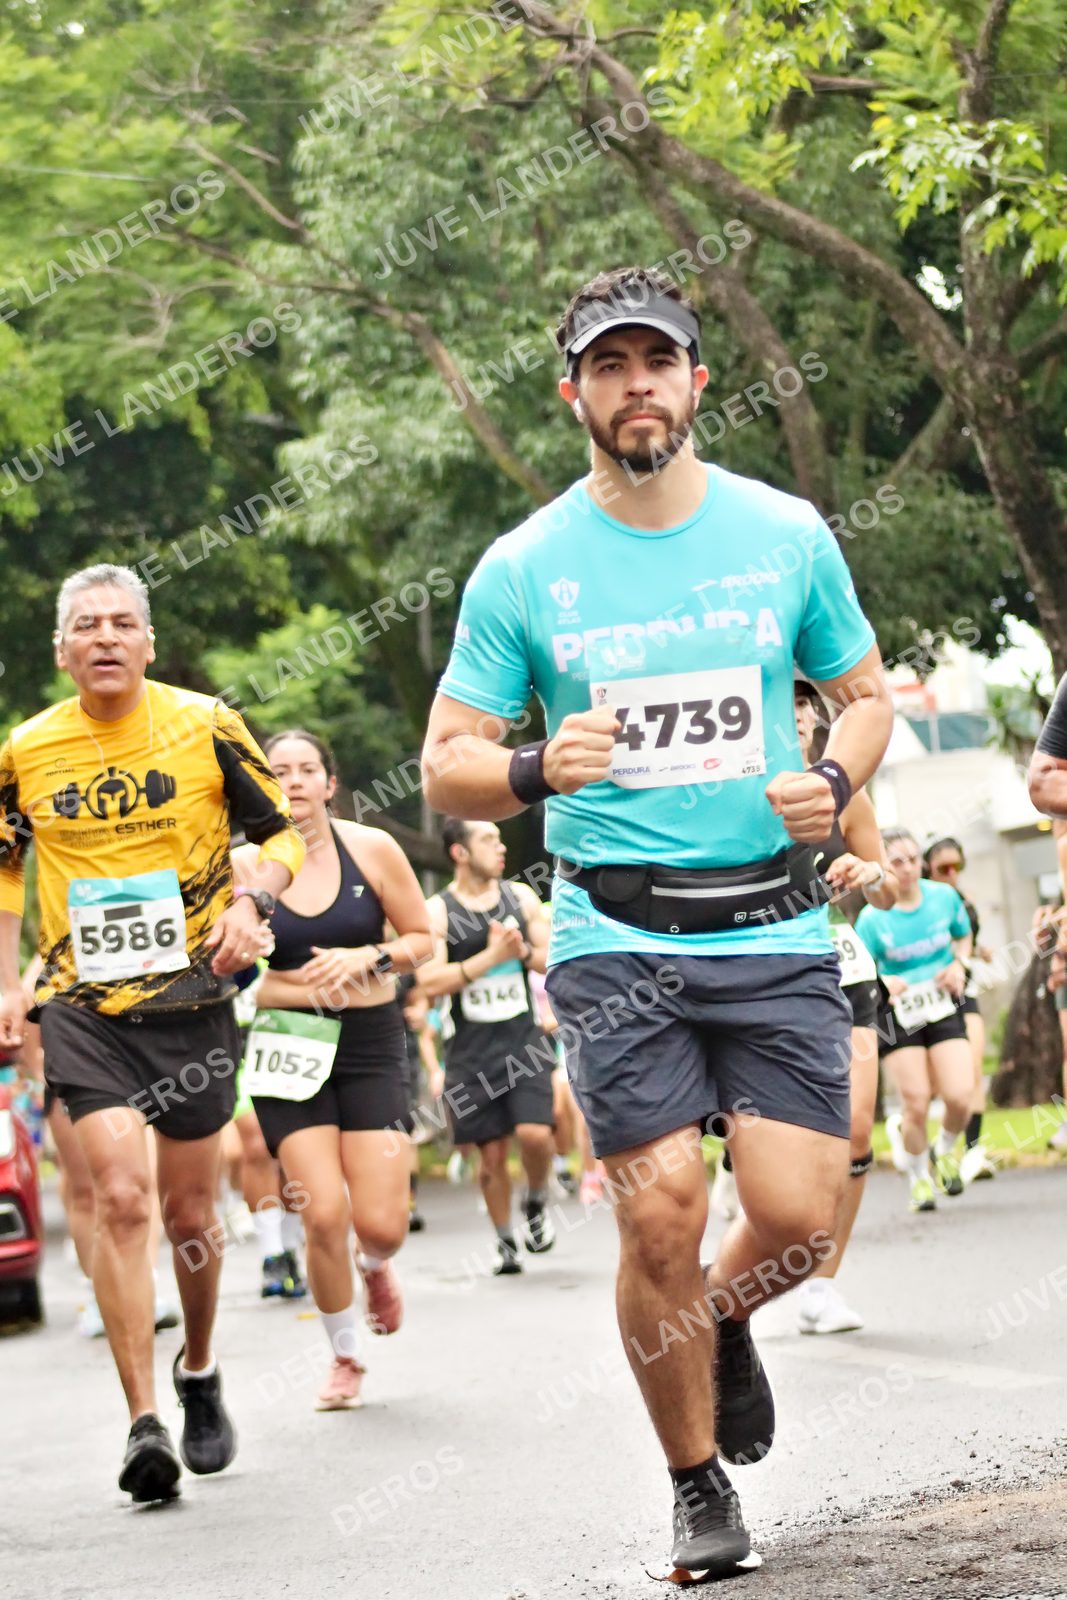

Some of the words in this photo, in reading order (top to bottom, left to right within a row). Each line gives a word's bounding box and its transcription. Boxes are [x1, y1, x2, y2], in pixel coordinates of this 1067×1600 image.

[720, 571, 781, 589] BROOKS
[613, 696, 751, 751] 4739
[612, 766, 651, 776] PERDURA
[115, 818, 177, 834] ESTHER
[80, 918, 177, 955] 5986
[469, 985, 519, 1005] 5146
[254, 1049, 322, 1080] 1052
